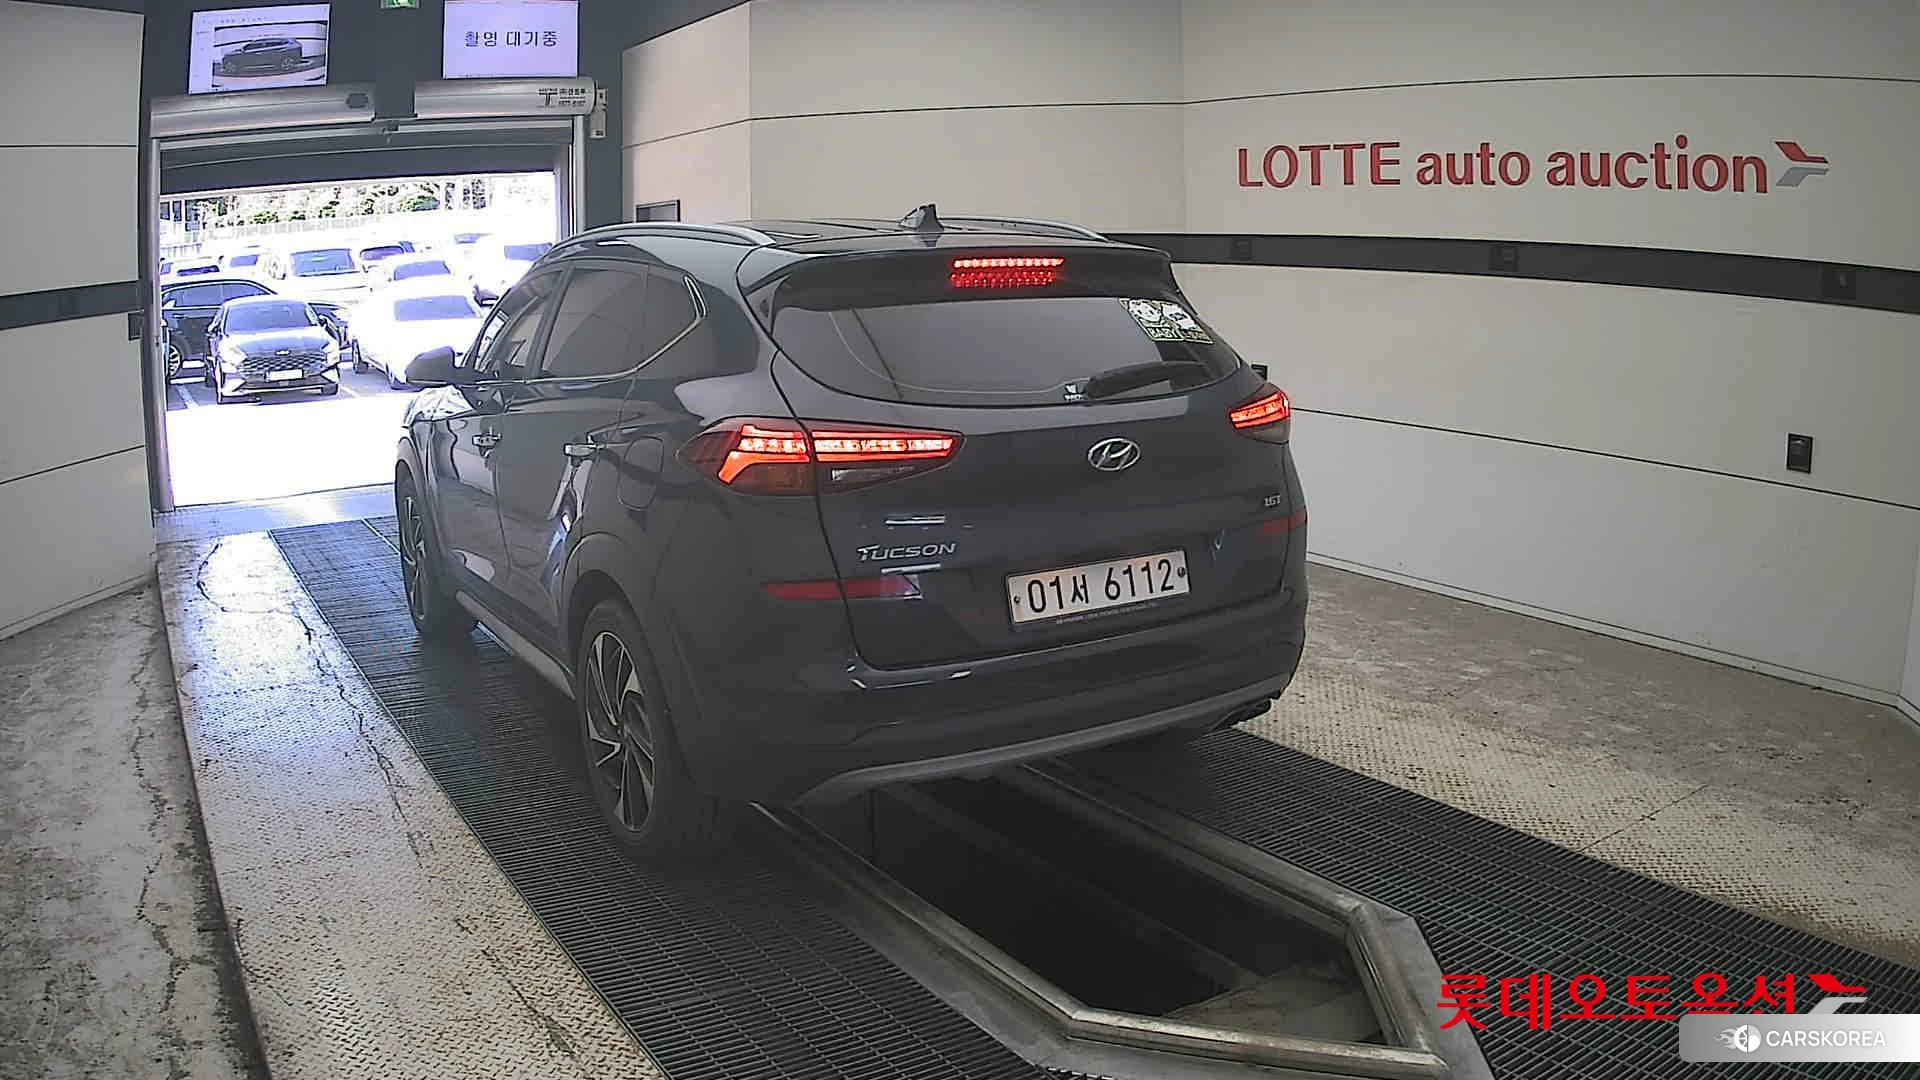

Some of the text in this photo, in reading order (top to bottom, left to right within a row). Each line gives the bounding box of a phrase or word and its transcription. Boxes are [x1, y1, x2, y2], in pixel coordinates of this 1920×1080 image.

[506, 31, 557, 47] 대기중
[1237, 134, 1768, 193] LOTTE auto auction
[857, 543, 956, 561] TUCSON
[1027, 574, 1089, 613] 01서
[1104, 558, 1175, 601] 6112
